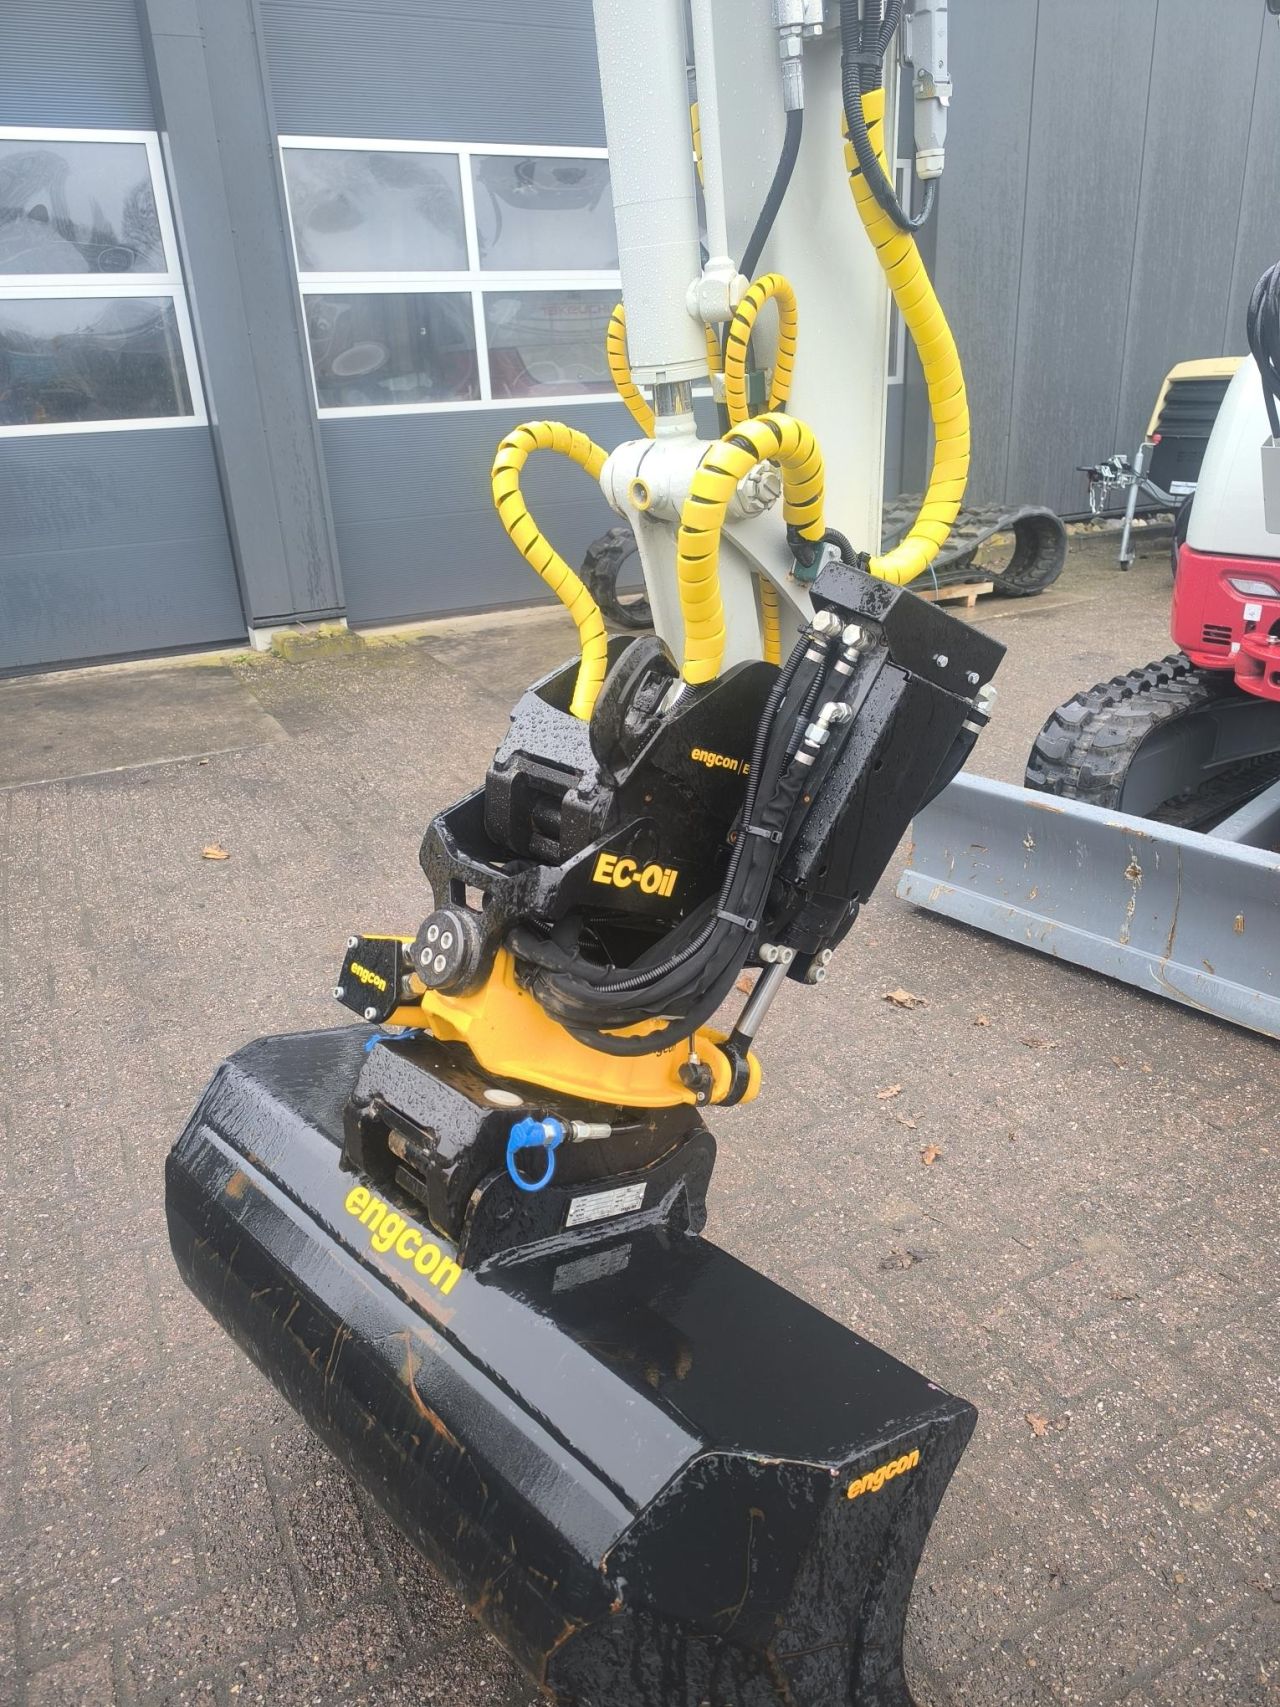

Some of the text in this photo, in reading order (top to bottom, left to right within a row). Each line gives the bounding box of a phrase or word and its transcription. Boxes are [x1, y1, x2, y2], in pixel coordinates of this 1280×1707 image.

[691, 748, 738, 770] engcon
[593, 853, 678, 897] EC-Oil
[350, 962, 387, 992] engcon
[345, 1186, 462, 1295] engcon
[847, 1449, 920, 1499] engcon
